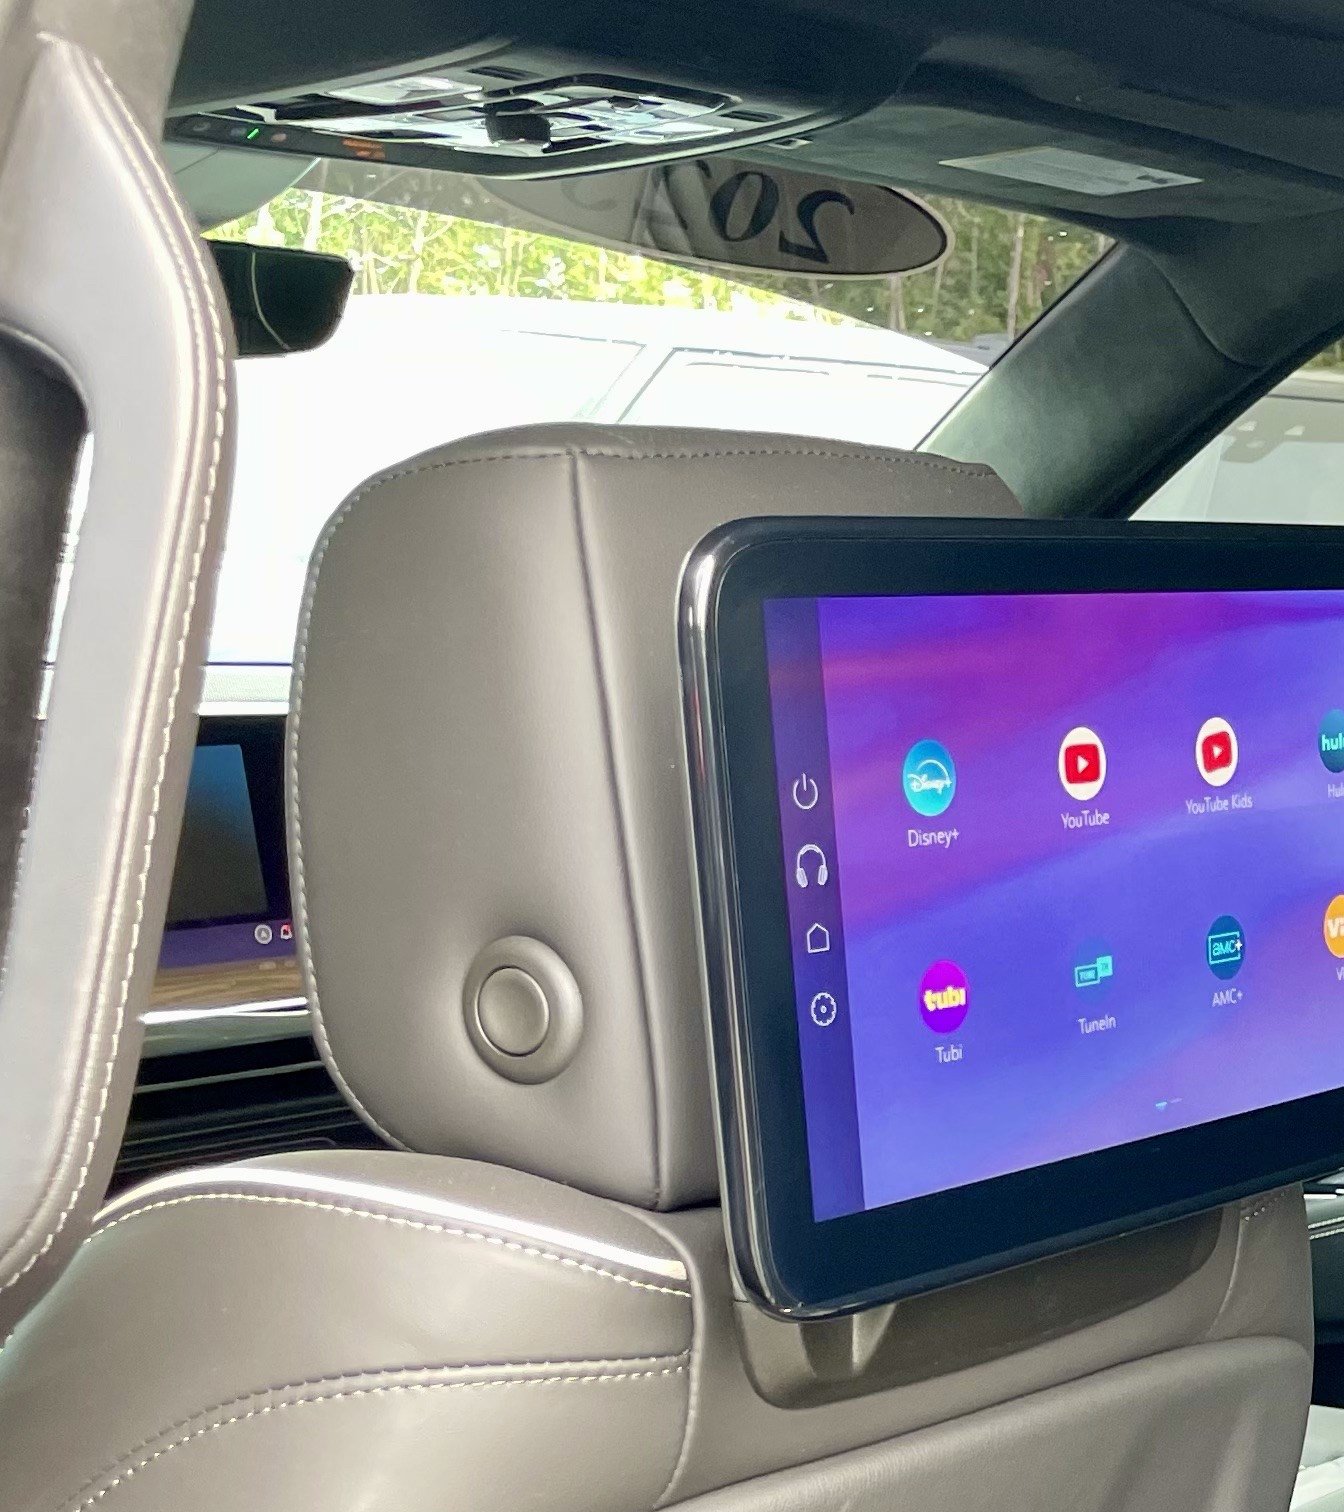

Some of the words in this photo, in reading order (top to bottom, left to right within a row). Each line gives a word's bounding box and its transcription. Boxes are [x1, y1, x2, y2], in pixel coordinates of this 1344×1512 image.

[1185, 796, 1229, 814] YouTube
[1231, 793, 1253, 810] Kids
[1060, 809, 1110, 829] YouTube
[907, 828, 959, 848] Disney+
[924, 985, 966, 1011] tubi
[1212, 988, 1243, 1008] AMC+
[1078, 1014, 1116, 1034] TuneIn
[935, 1044, 963, 1063] Tubi
